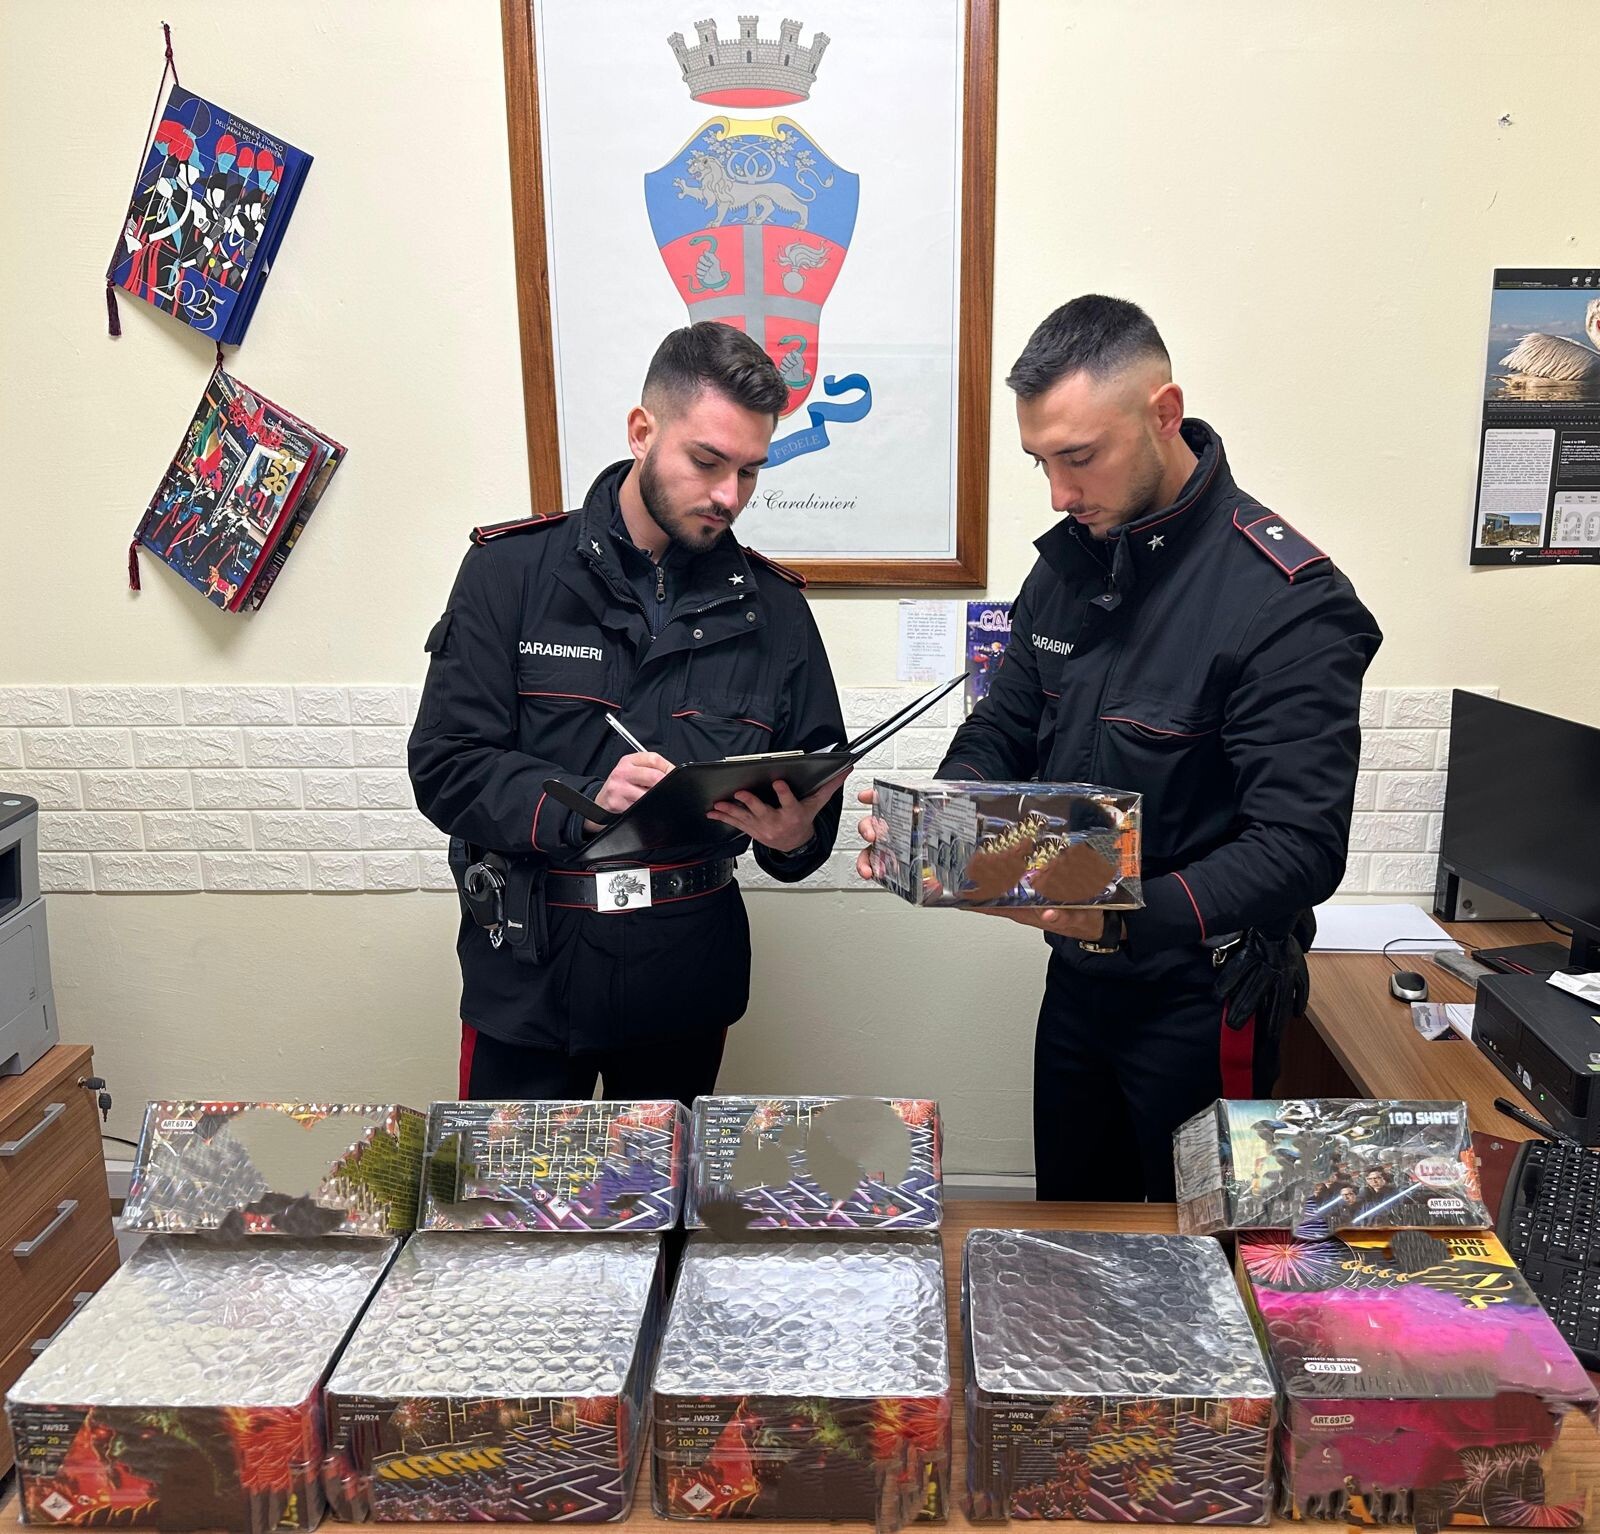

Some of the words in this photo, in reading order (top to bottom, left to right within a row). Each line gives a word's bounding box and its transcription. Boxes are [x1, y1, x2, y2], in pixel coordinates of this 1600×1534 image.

[229, 118, 260, 139] CALENDARIO
[261, 136, 283, 152] STORICO
[151, 264, 227, 331] 2025
[774, 435, 821, 459] FEDELE
[745, 496, 759, 509] ei
[763, 489, 858, 510] Carabinieri
[519, 641, 602, 661] CARABINIERI
[1032, 633, 1074, 655] CARABIN
[1389, 1112, 1413, 1124] 100
[1415, 1112, 1459, 1124] SHOTS
[1453, 1246, 1491, 1256] 100
[1309, 1363, 1356, 1371] ART.697C
[1313, 1416, 1351, 1424] ART.697C
[697, 1427, 709, 1435] 20
